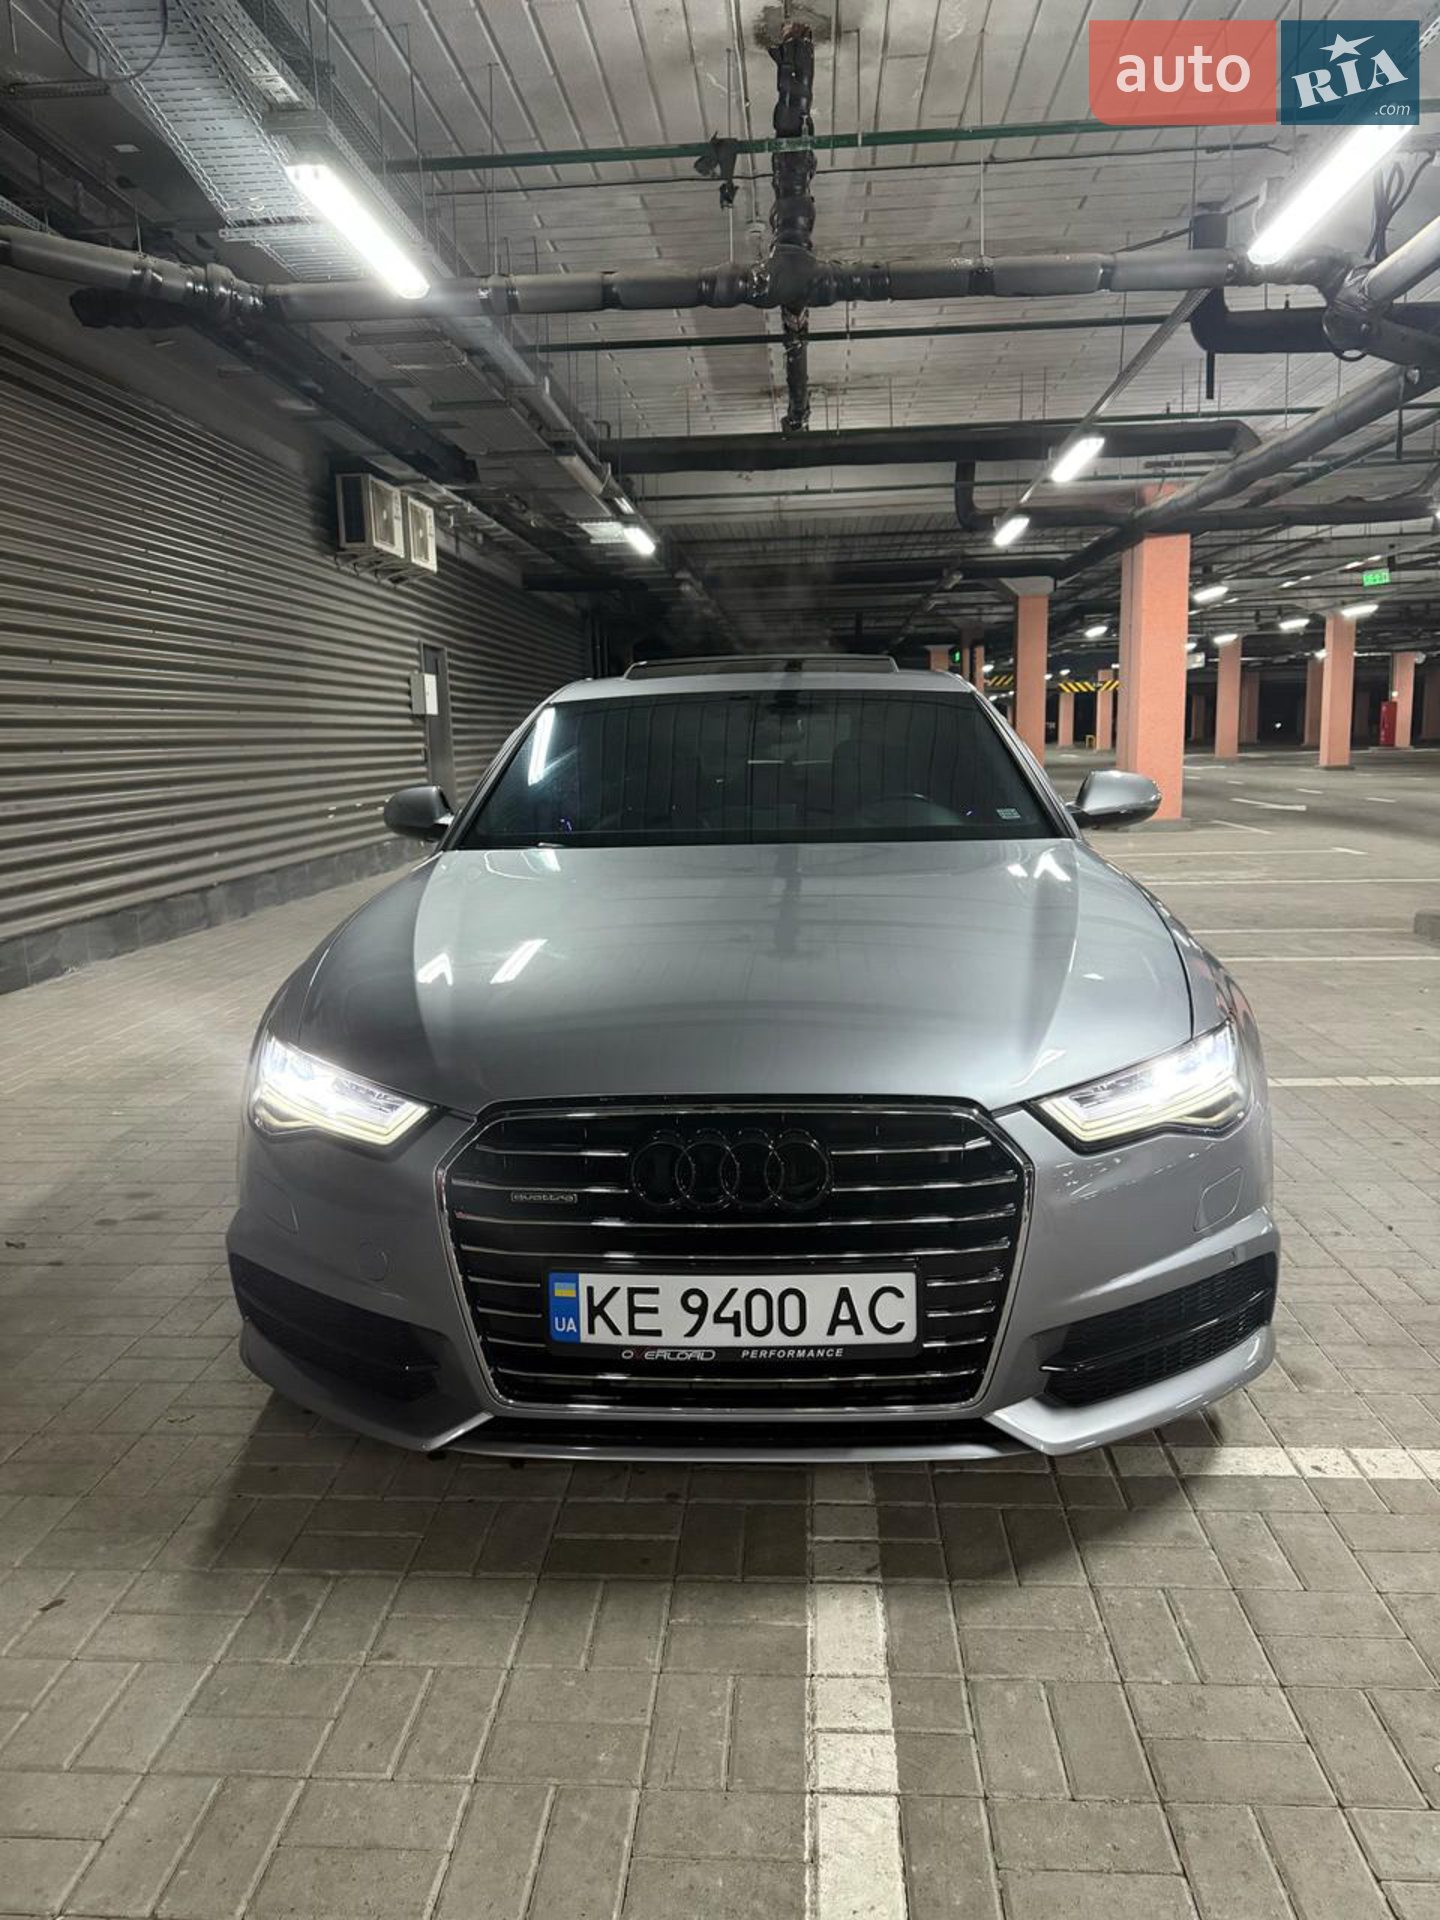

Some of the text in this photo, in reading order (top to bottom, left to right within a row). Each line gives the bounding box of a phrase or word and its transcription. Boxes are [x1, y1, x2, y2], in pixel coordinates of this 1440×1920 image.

[586, 1285, 906, 1338] KE 9400 AC
[554, 1316, 577, 1334] UA
[741, 1347, 844, 1360] PERFORMANCE
